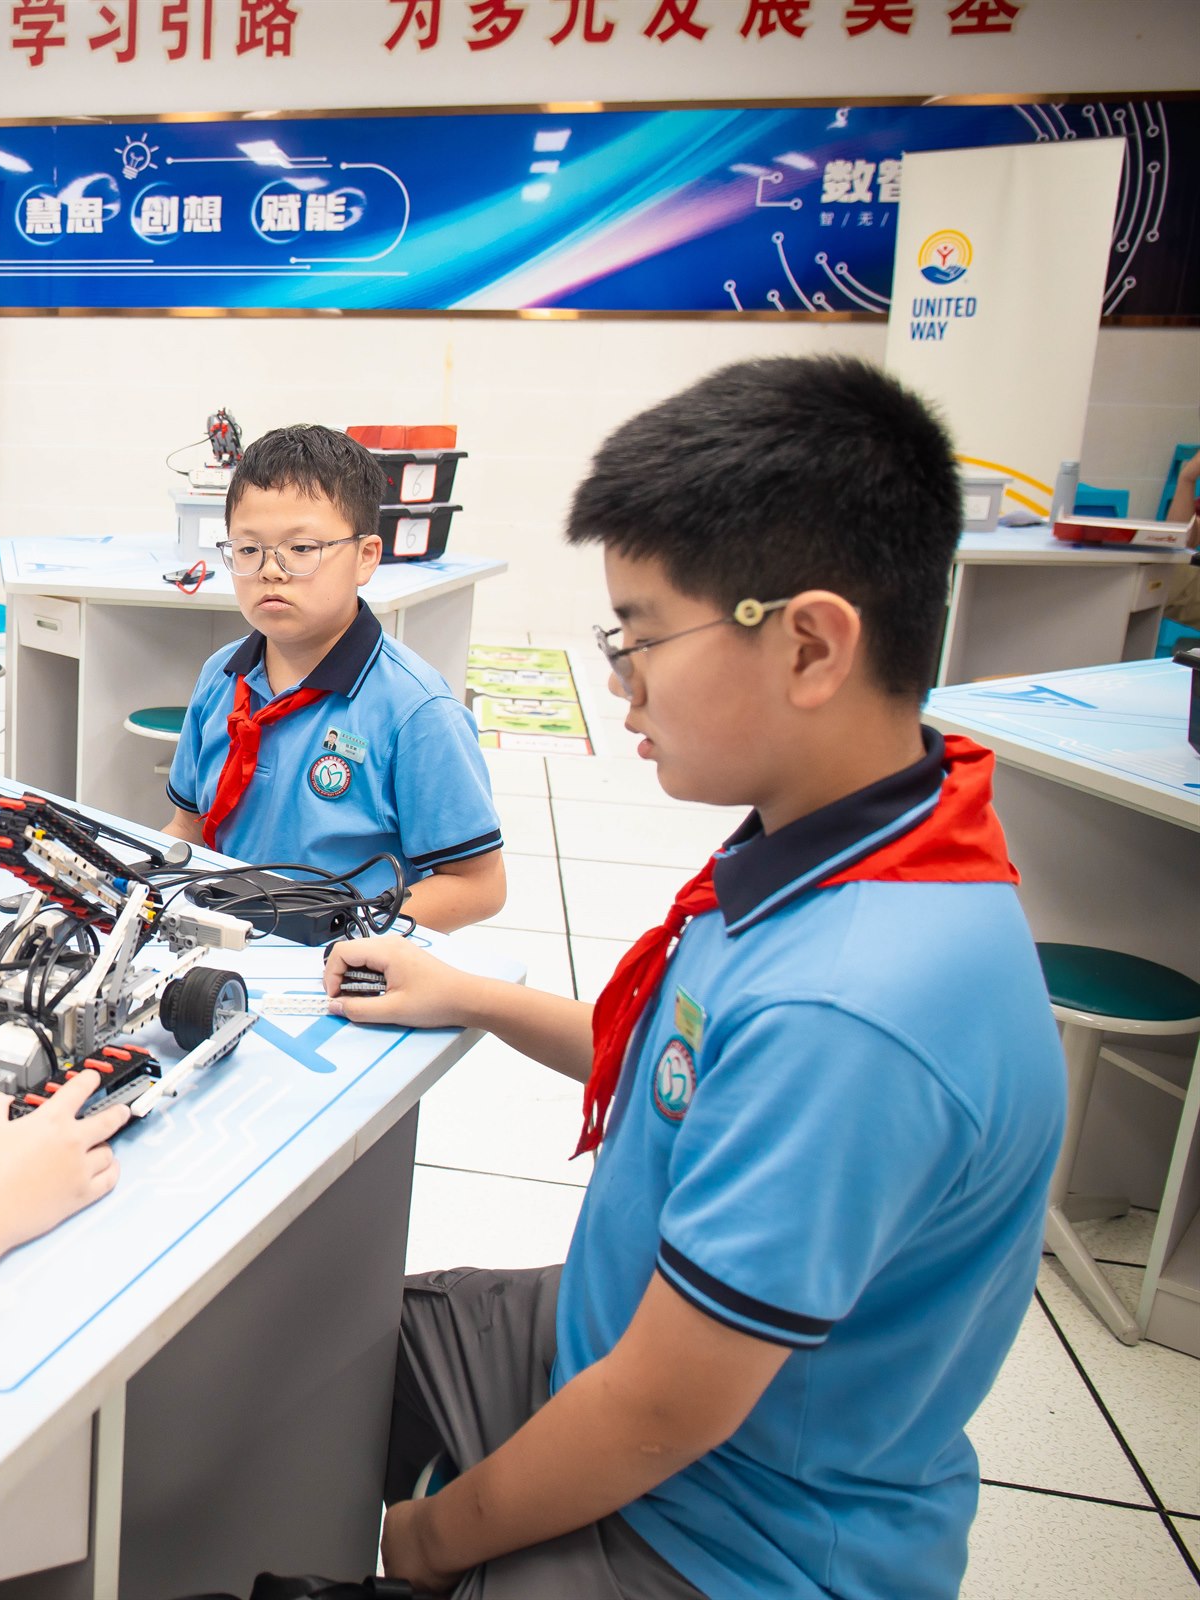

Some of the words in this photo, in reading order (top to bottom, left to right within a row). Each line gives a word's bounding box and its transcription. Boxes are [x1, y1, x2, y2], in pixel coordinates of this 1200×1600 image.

[140, 195, 223, 233] 创想
[260, 193, 347, 232] 赋能
[912, 296, 977, 318] UNITED
[910, 321, 949, 341] WAY
[411, 468, 425, 497] 6
[405, 522, 418, 549] 6
